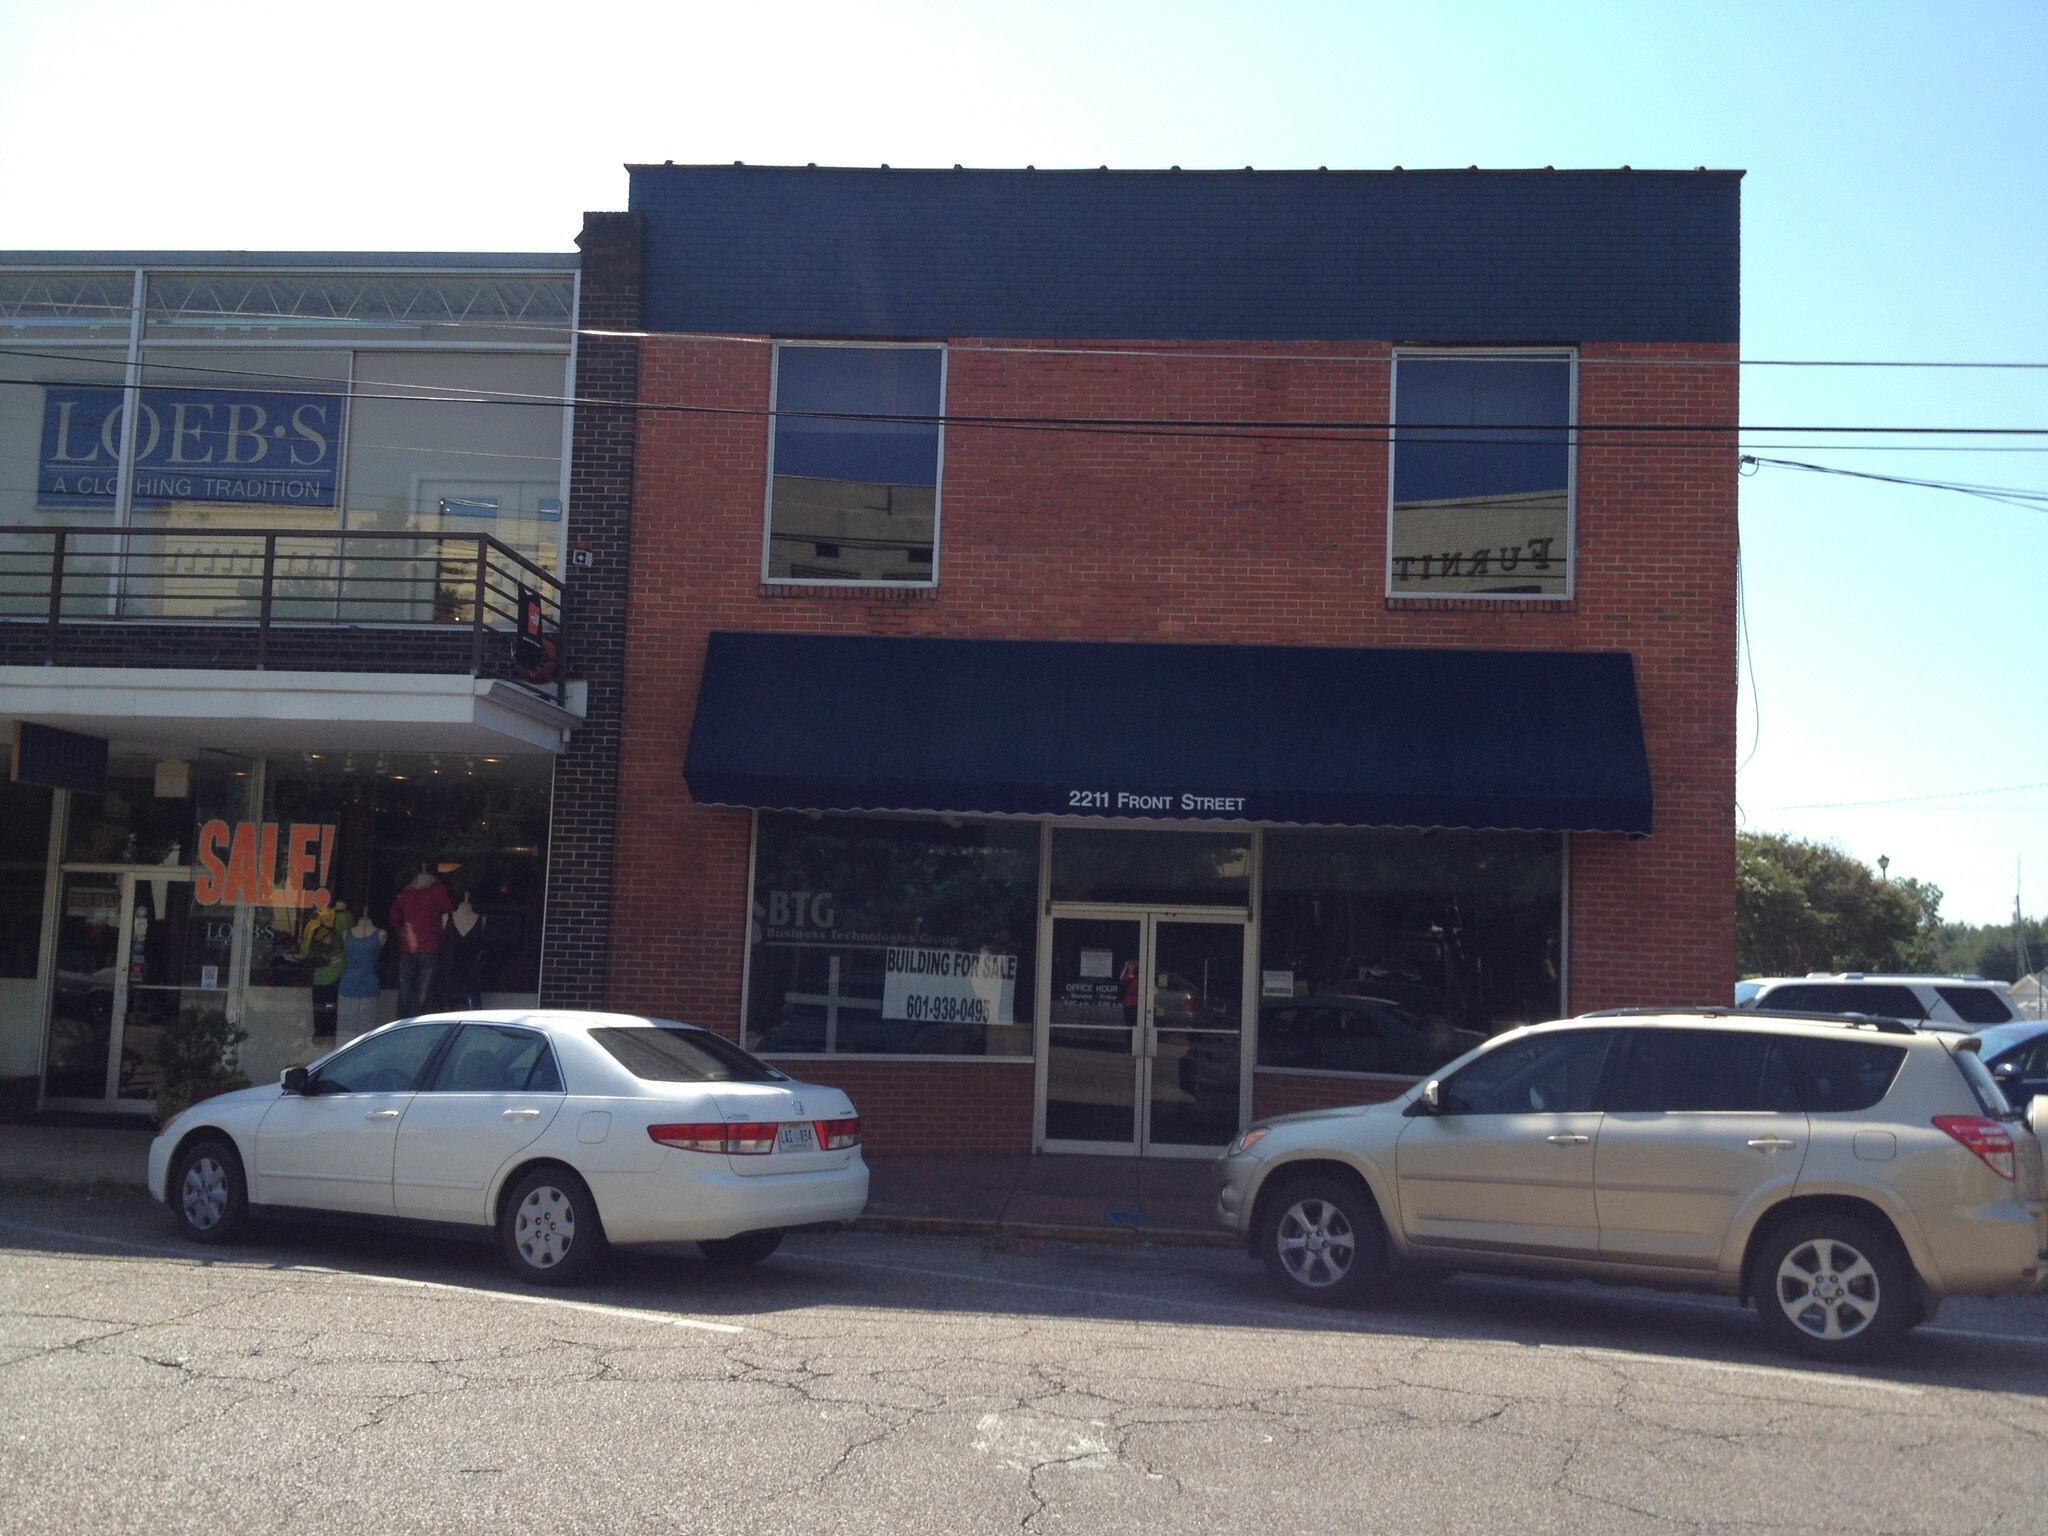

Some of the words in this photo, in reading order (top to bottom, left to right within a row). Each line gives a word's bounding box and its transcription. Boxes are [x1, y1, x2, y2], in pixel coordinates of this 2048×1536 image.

[53, 477, 67, 493] A
[77, 476, 192, 497] CLOHING
[204, 479, 320, 498] TRADITION
[1069, 790, 1109, 808] 2211
[195, 819, 336, 909] SALE!
[769, 891, 834, 928] BTG
[766, 927, 827, 941] Business
[831, 929, 916, 946] Technologies
[919, 933, 960, 946] Group
[887, 948, 951, 976] BUILDING
[953, 952, 980, 978] FOR
[982, 955, 1016, 980] SALE
[1065, 983, 1094, 992] OFFICE
